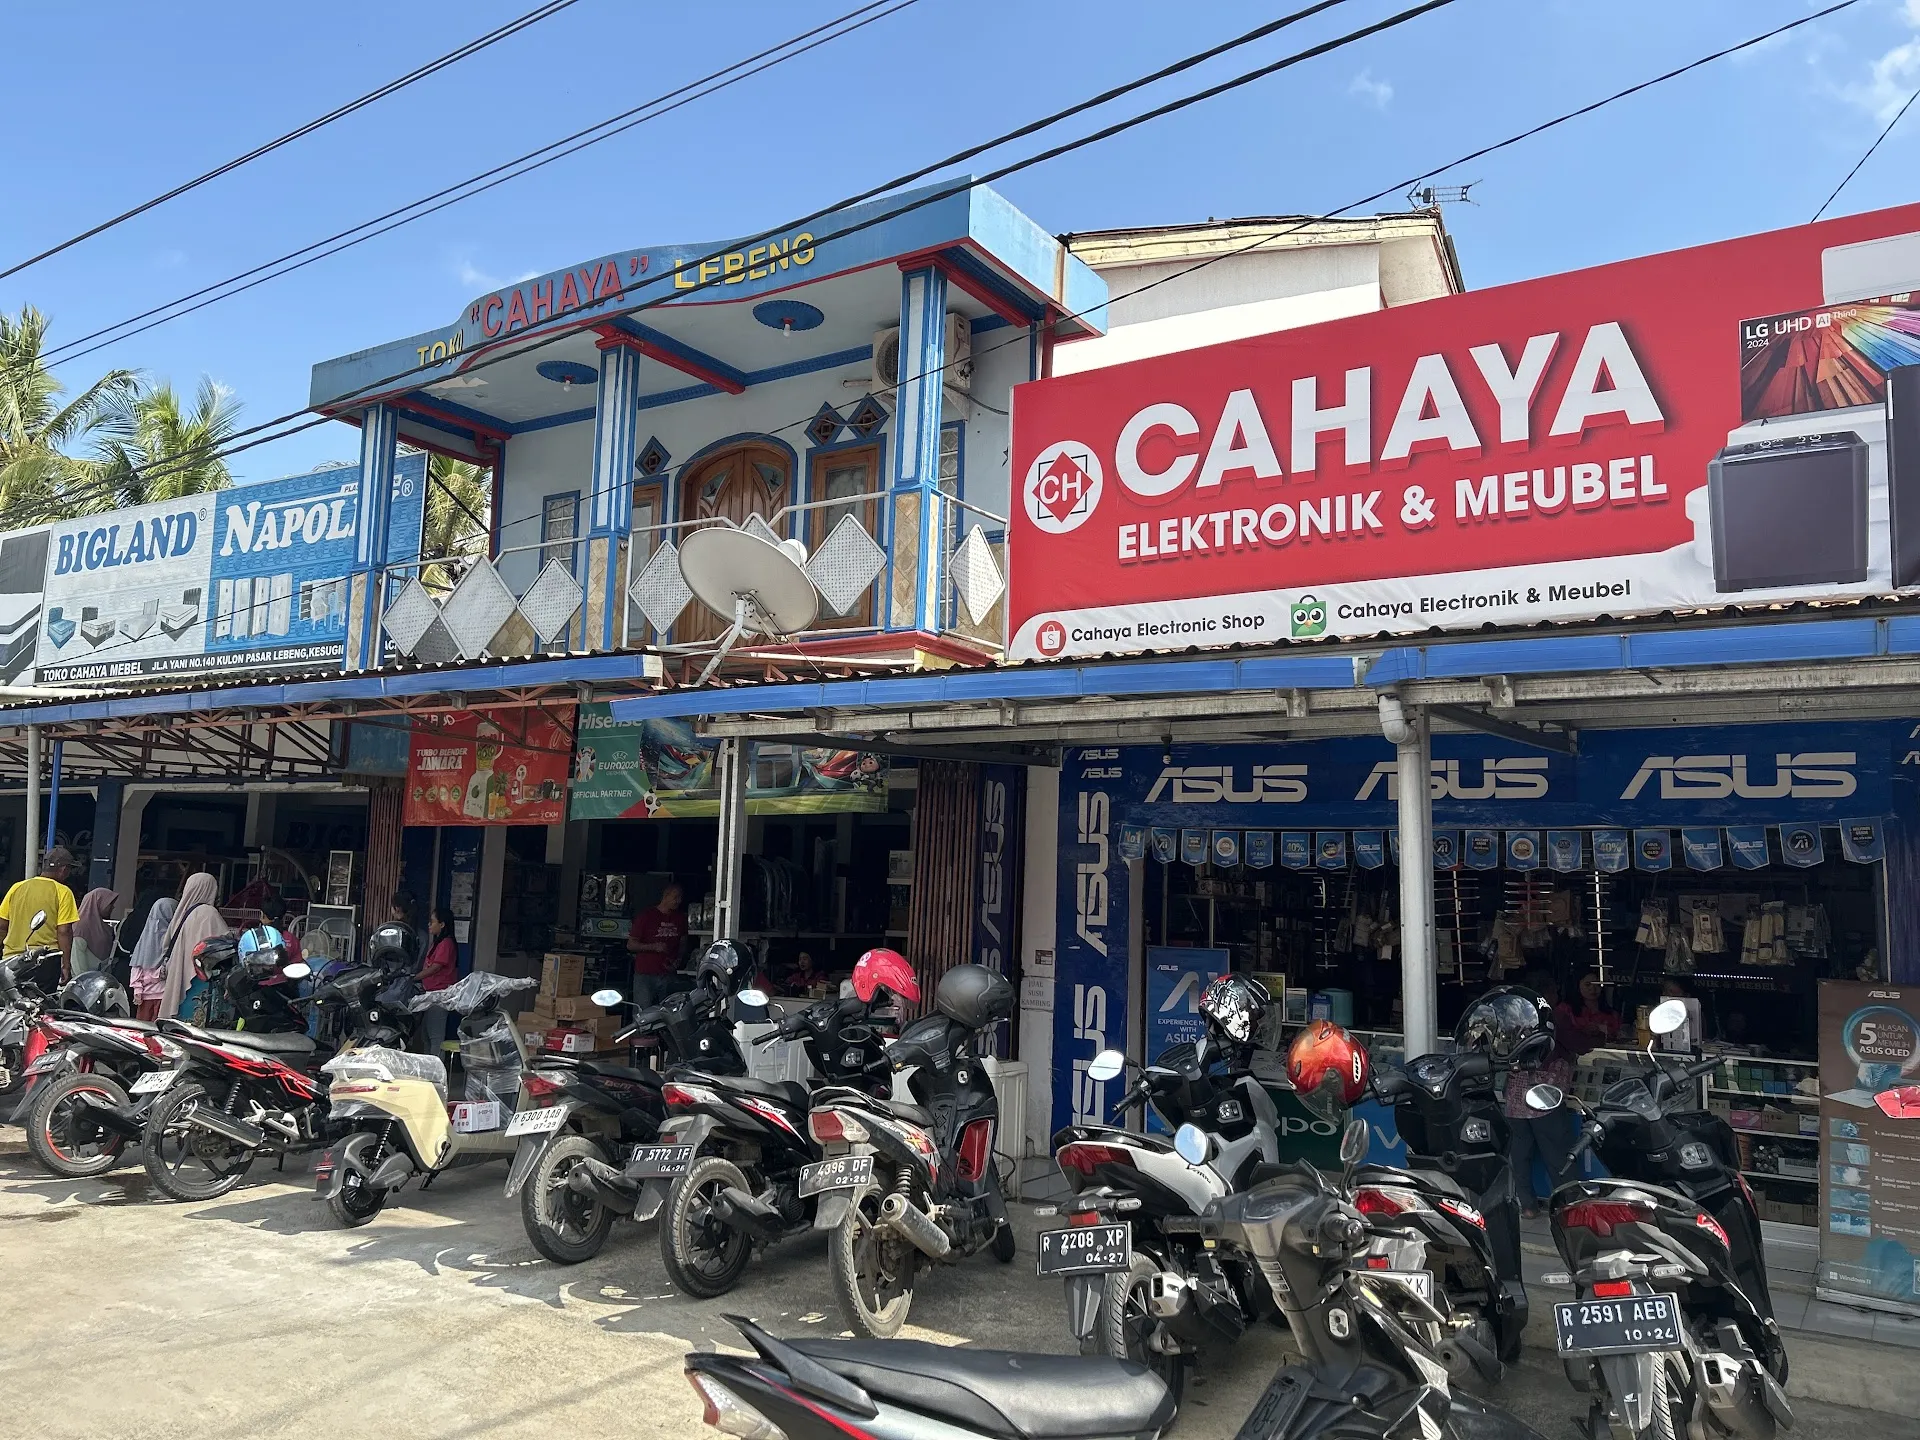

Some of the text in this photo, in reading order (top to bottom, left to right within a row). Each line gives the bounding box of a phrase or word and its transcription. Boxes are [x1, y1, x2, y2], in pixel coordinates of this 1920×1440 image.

[674, 232, 816, 290] LEBENG
[1746, 323, 1769, 340] LG
[1774, 316, 1812, 335] UHD
[1817, 315, 1831, 328] AI
[1747, 338, 1770, 349] 2024
[1115, 321, 1666, 497] CAHAYA
[1039, 473, 1084, 505] CH
[1117, 454, 1668, 562] ELEKTRONIK & MEUBEL
[54, 512, 197, 576] BIGLAND
[1337, 579, 1631, 622] Cahaya Electronik & Meubel
[1071, 612, 1265, 643] Cahaya Electronic Shop
[43, 668, 67, 682] TOKO
[69, 665, 107, 680] CAHAYA
[110, 661, 144, 675] MEBEL
[151, 659, 168, 671] JL.A
[169, 658, 188, 670] YANI
[189, 655, 216, 667] NO.140
[216, 653, 244, 666] KULON
[245, 650, 272, 663] PASAR
[416, 748, 468, 757] TURBO BLENDER
[1078, 749, 1119, 760] ASUS
[417, 755, 463, 771] JAWARA
[598, 760, 639, 771] EURO2024
[1080, 767, 1122, 779] ASUS
[1619, 751, 1858, 800] ASUS
[1143, 764, 1308, 803] ASUS
[573, 789, 633, 800] OFFICIAL PARTNER
[1286, 842, 1305, 852] 40%
[1600, 842, 1622, 853] 40%
[1687, 843, 1718, 851] ASUS
[1732, 840, 1764, 850] ASUS
[982, 779, 1006, 945] ASUS
[1076, 791, 1111, 958] ASUS
[1867, 990, 1901, 999] ASUS
[1021, 998, 1051, 1007] KAMBING
[1157, 1018, 1198, 1027] EXPERIENCE
[1165, 1033, 1198, 1044] ASUS
[1859, 1022, 1909, 1045] 5 ALASAN
[1877, 1032, 1904, 1040] UNTUK
[1877, 1039, 1910, 1048] MEMILIH
[1072, 983, 1107, 1126] SUS
[1859, 1045, 1910, 1057] ASUS OLED
[520, 1110, 543, 1122] 6300
[635, 1150, 642, 1161] R
[648, 1148, 670, 1160] 5772
[802, 1159, 868, 1181] R 4396 DF
[1043, 1229, 1124, 1252] R 2208 XP
[1839, 1274, 1866, 1284] Windows
[1561, 1300, 1667, 1327] R 2591 AEB
